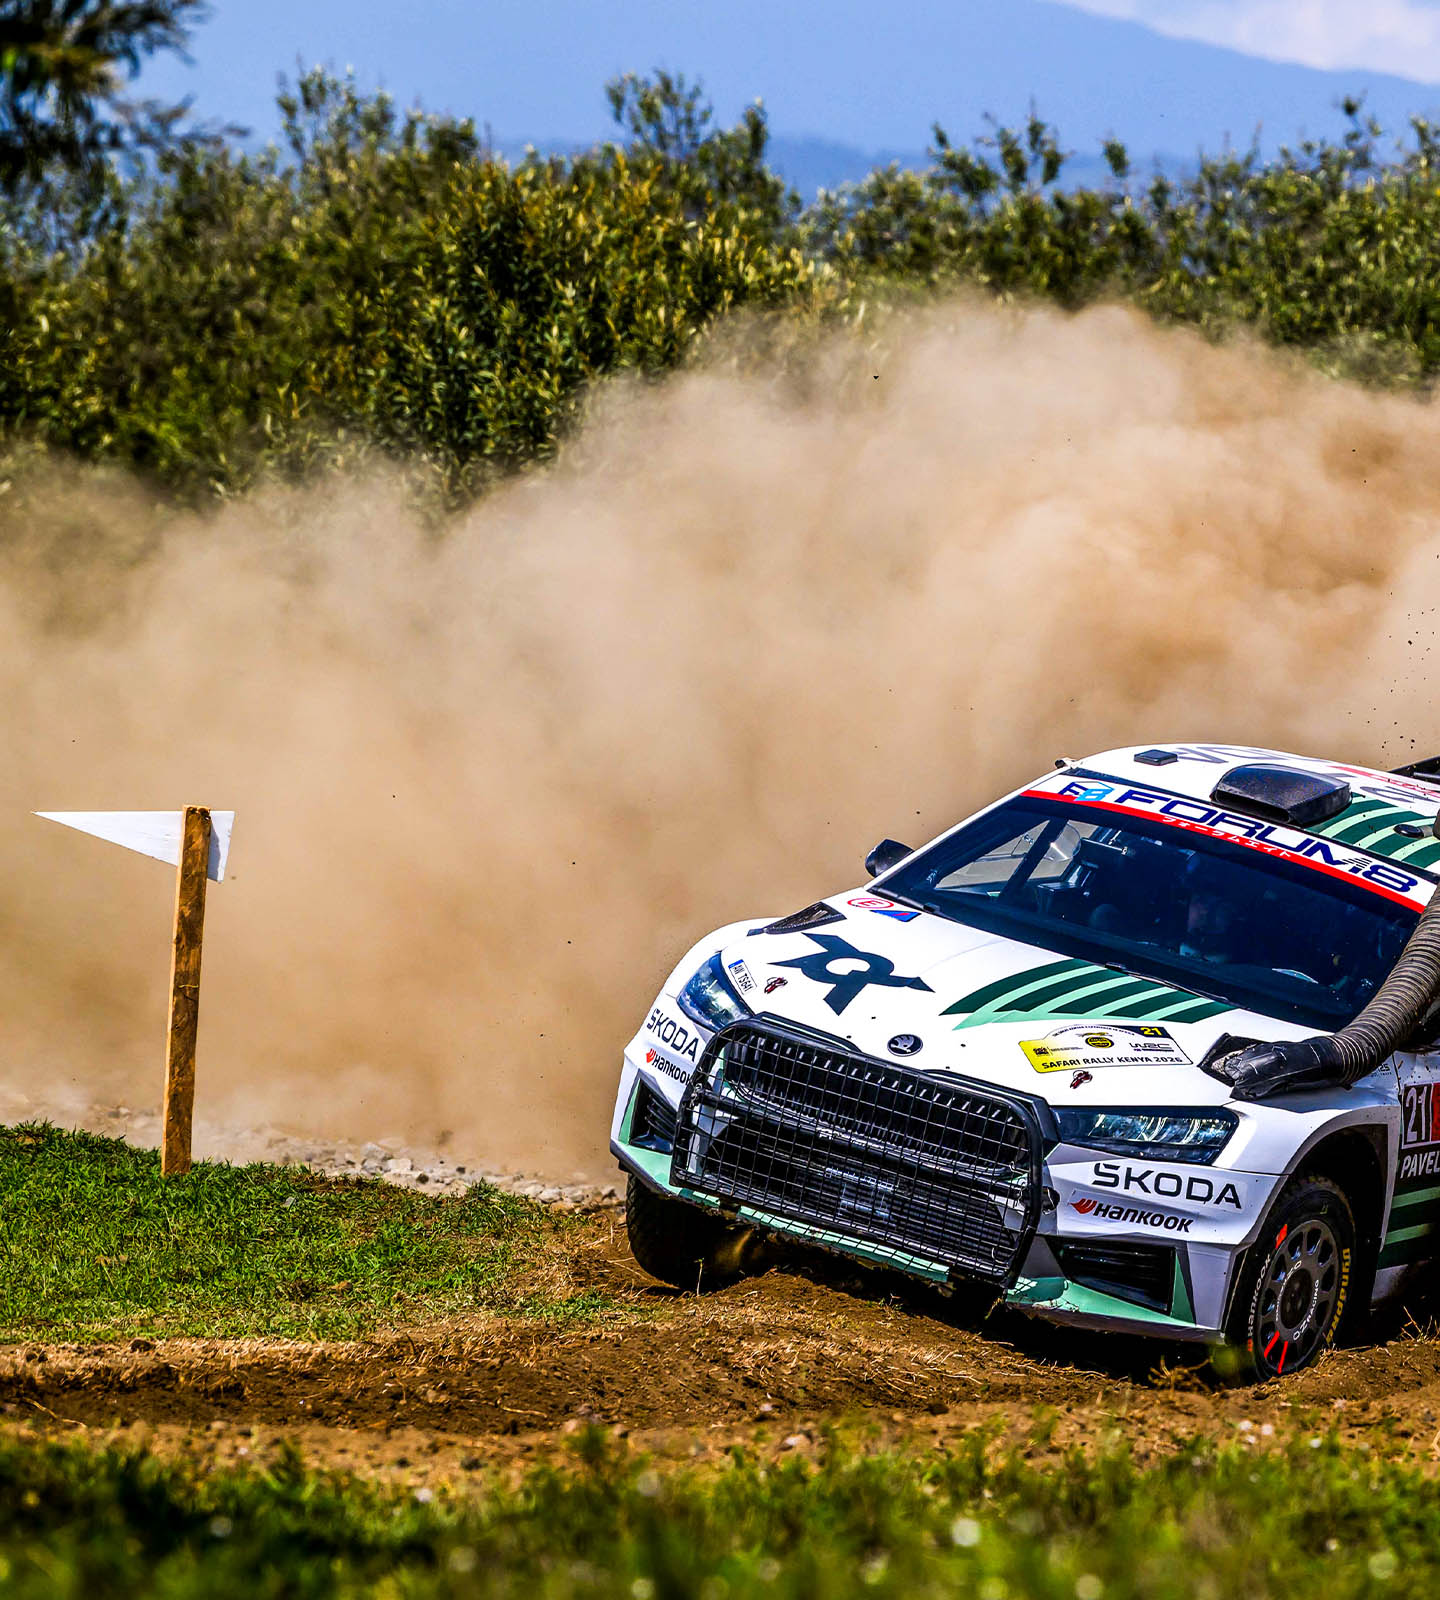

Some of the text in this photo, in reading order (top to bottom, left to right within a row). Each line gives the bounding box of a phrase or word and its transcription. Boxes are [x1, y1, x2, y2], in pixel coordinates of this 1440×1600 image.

[1114, 789, 1418, 893] FORUM8
[1162, 816, 1291, 857] フォーラムエイト
[646, 1008, 699, 1062] SKODA
[1140, 1027, 1163, 1036] 21
[1042, 1059, 1081, 1069] SAFARI
[1083, 1057, 1114, 1065] RALLY
[1405, 1086, 1427, 1143] 21
[1092, 1162, 1242, 1209] SKODA
[1400, 1151, 1440, 1179] PAVEL
